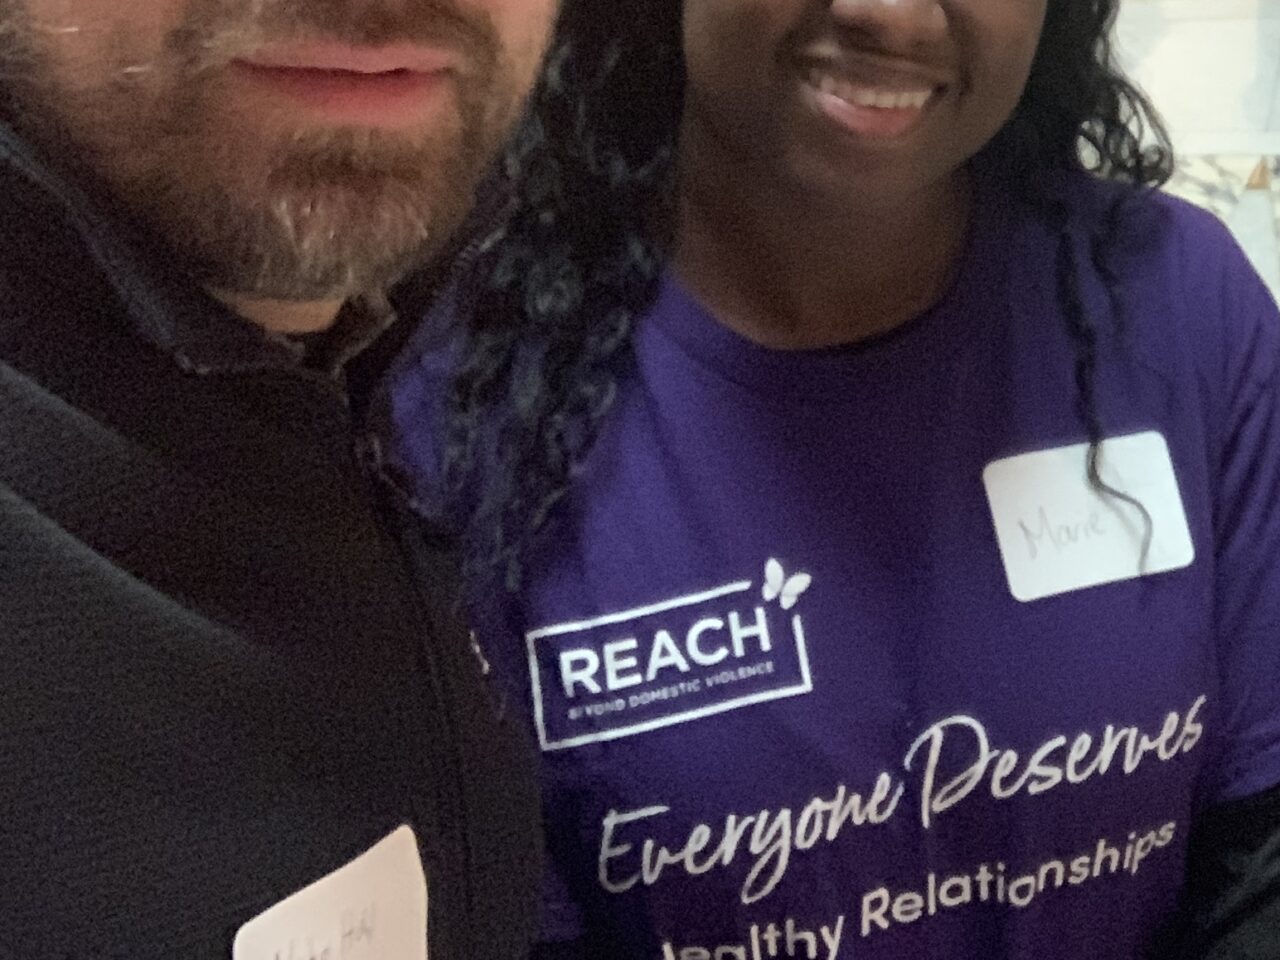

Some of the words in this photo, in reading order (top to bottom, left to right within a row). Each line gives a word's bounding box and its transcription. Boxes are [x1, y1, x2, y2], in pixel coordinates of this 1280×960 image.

[559, 606, 772, 697] REACH
[628, 678, 700, 708] DOMESTIC
[705, 660, 774, 688] VIOLENCE
[599, 770, 904, 904] Everyone
[904, 694, 1207, 828] Deserves
[662, 914, 845, 960] ealthy
[860, 820, 1177, 937] Relationships
